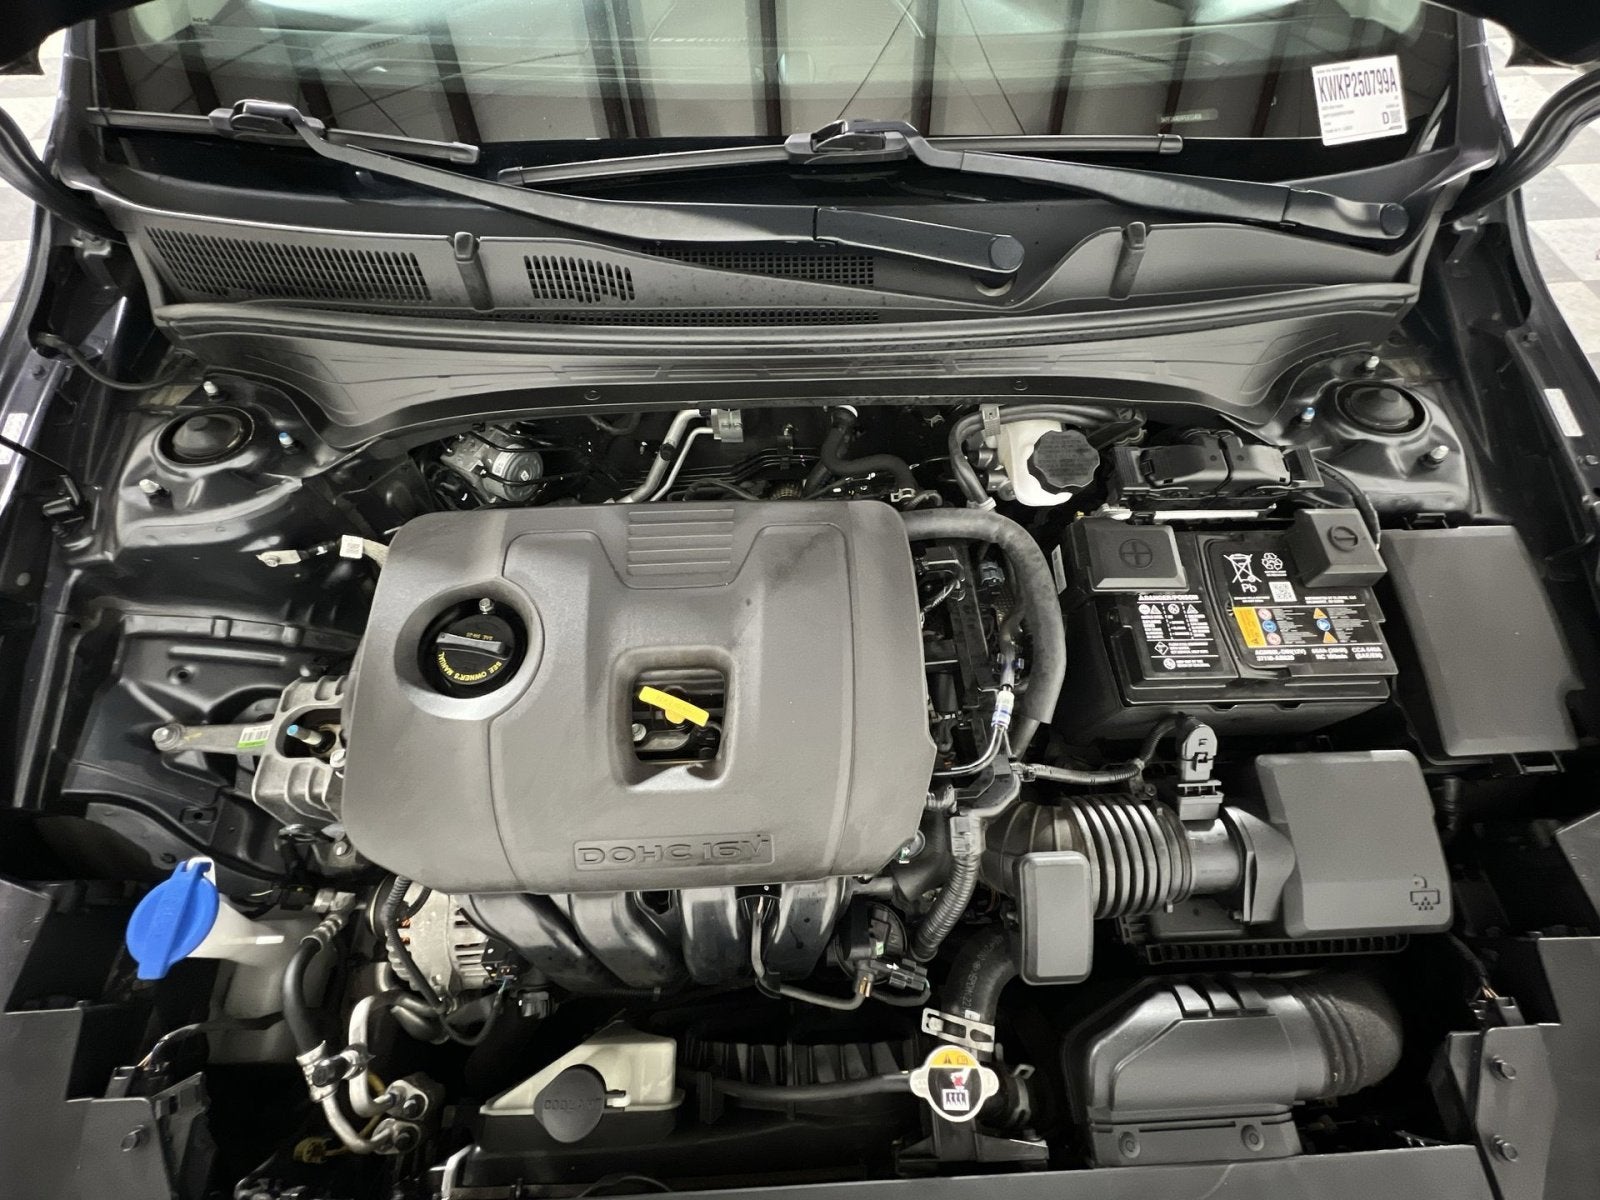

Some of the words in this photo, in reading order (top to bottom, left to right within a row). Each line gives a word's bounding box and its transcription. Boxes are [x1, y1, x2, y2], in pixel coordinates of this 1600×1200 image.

[1318, 67, 1397, 102] KWKP250799A
[1382, 111, 1389, 125] D
[1241, 583, 1257, 593] Pb
[437, 652, 455, 676] MANUAL
[489, 661, 502, 674] SEE
[454, 672, 487, 682] OWNER'S
[577, 843, 692, 865] DOHC
[702, 838, 770, 861] 16V
